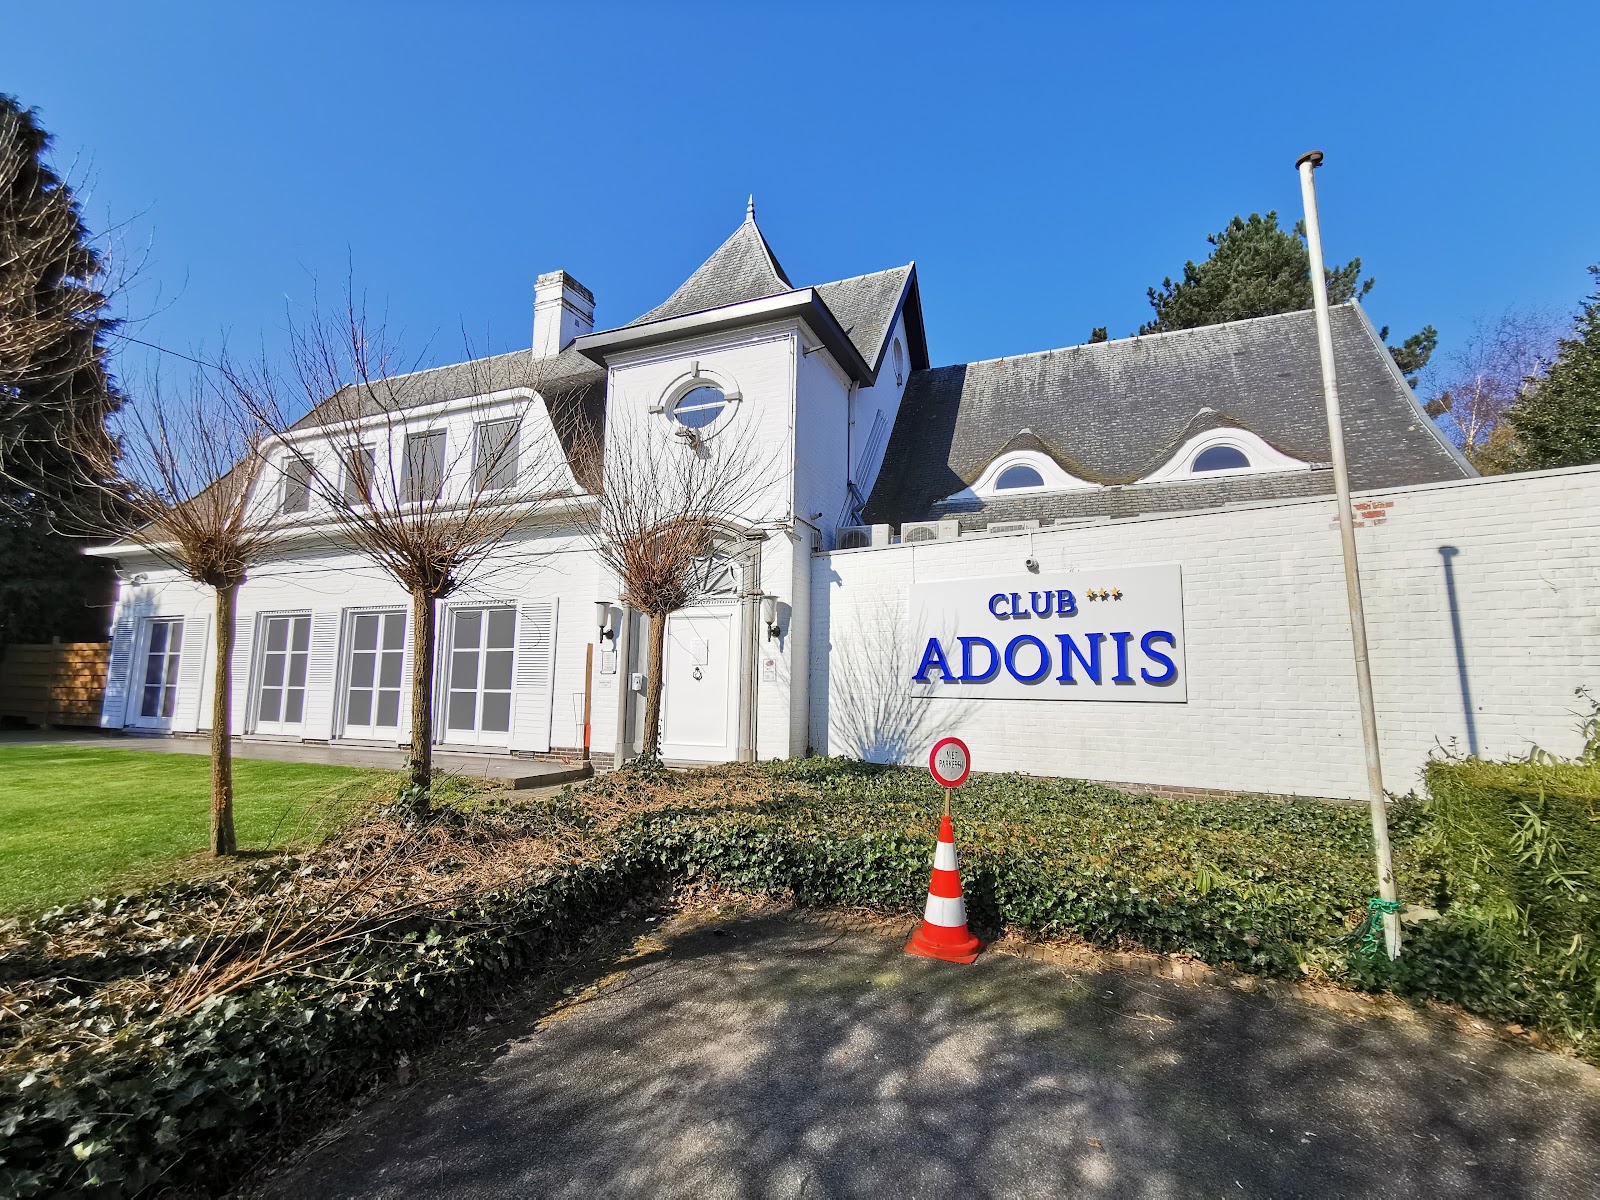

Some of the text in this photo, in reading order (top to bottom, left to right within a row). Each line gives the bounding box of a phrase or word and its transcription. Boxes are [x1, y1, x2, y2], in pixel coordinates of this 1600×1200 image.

[988, 589, 1077, 617] CLUB
[911, 630, 1177, 684] ADONIS
[946, 750, 958, 760] NIET
